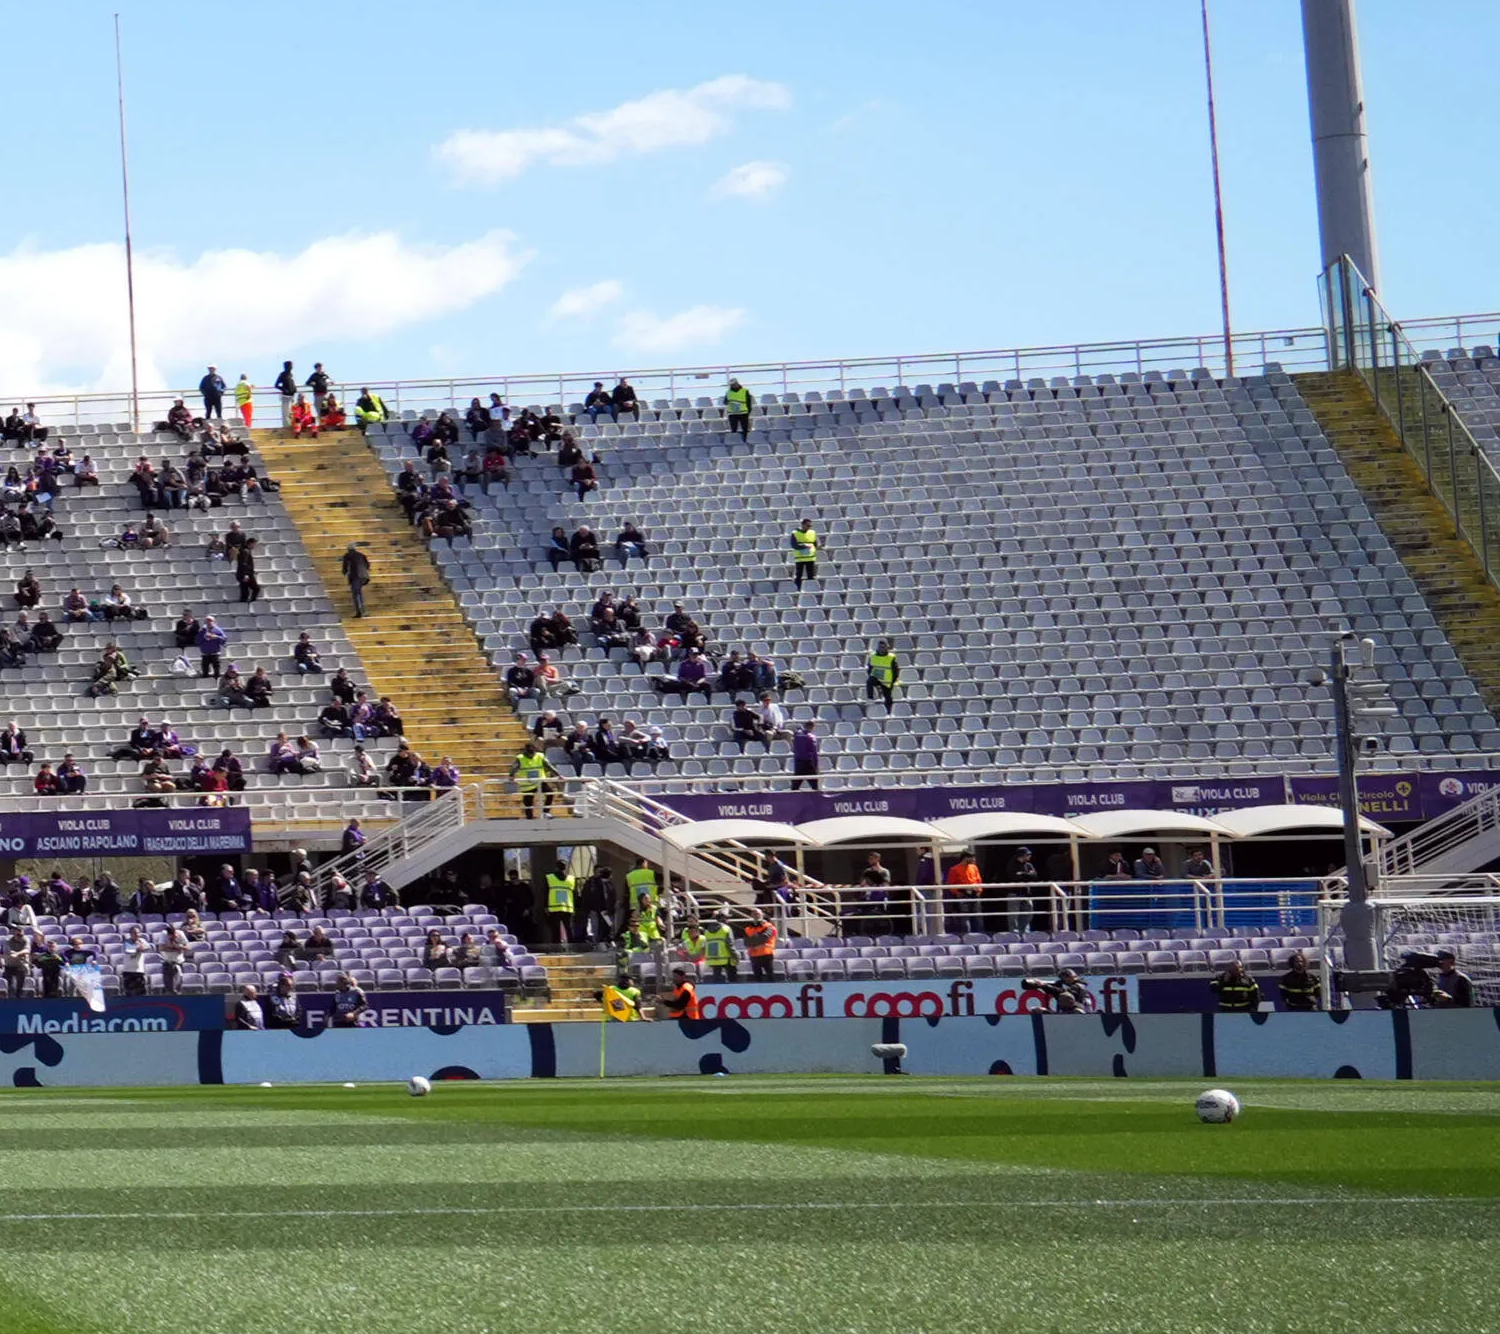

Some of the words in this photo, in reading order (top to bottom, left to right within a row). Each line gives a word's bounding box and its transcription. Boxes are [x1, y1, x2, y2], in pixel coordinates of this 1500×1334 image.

[1067, 794, 1096, 806] VIOLA
[1098, 793, 1125, 805] CLUB
[1201, 789, 1231, 799] VIOLA
[1233, 788, 1260, 798] CLUB
[834, 802, 862, 813] VIOLA
[864, 801, 889, 812] CLUB
[949, 798, 978, 810] VIOLA
[980, 797, 1005, 808] CLUB
[718, 805, 746, 816] VIOLA
[748, 804, 773, 815] CLUB
[58, 820, 83, 831] VIOLA
[85, 819, 110, 830] CLUB
[168, 819, 193, 831] VIOLA
[195, 819, 220, 830] CLUB
[37, 836, 80, 851] ASCIANO
[82, 835, 137, 850] RAPOLANO
[17, 1011, 168, 1034] Mediacom
[306, 1007, 497, 1029] FIRENTINA
